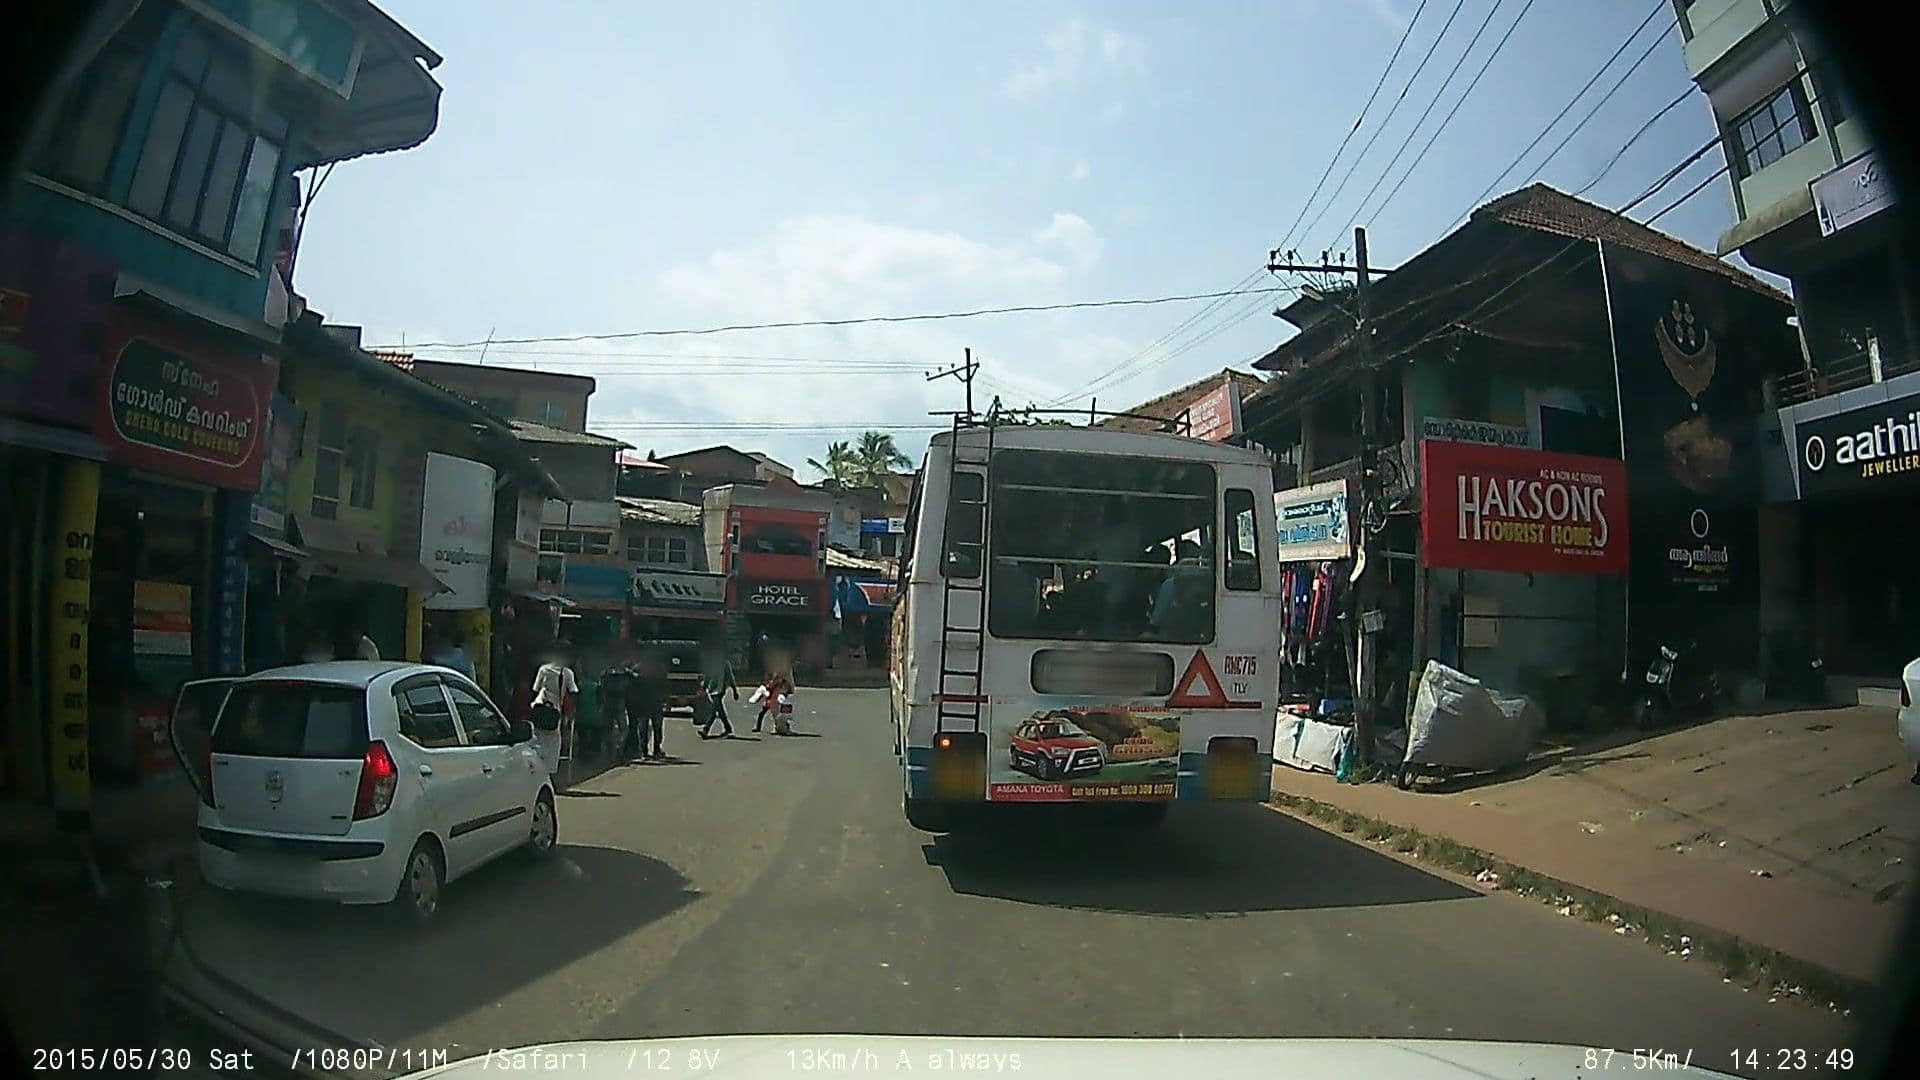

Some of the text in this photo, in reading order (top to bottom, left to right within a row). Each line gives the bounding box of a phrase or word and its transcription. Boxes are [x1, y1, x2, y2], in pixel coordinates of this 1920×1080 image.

[1457, 474, 1609, 548] HAKSONS
[1483, 518, 1593, 547] TOURIST HOME
[758, 585, 801, 595] HOTEL
[750, 594, 809, 606] GRACE
[996, 784, 1028, 793] AMANA
[1030, 784, 1064, 794] TOYOTA
